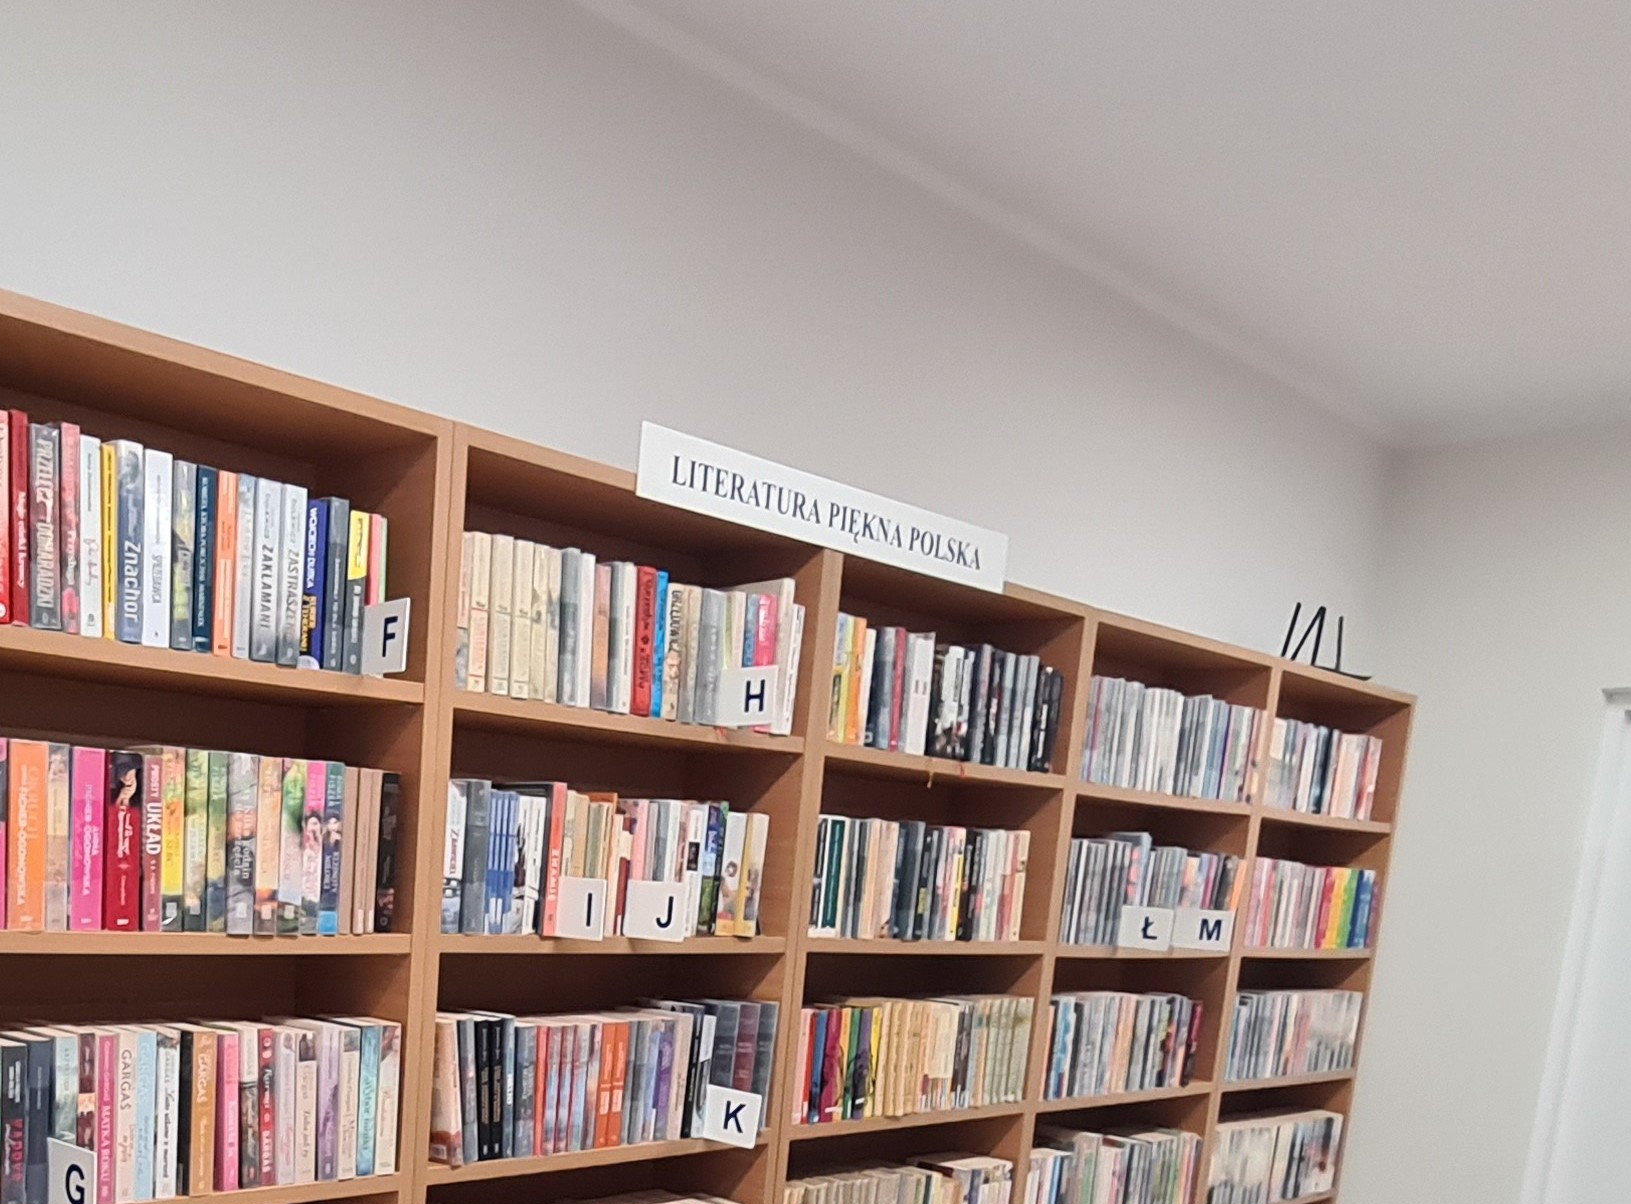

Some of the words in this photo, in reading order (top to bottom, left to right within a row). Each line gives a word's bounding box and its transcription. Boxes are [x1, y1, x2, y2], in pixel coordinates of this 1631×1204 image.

[671, 455, 821, 525] LITERATURA
[828, 502, 903, 544] PIĘKNA
[908, 527, 982, 571] POLSKA
[308, 507, 319, 557] WOJCIECH
[123, 539, 142, 624] Znachor
[305, 557, 318, 589] DUTKA
[382, 616, 398, 657] F
[744, 679, 766, 713] H
[149, 765, 160, 798] PROSTY
[145, 802, 162, 855] UKŁAD
[586, 893, 593, 927] I
[656, 896, 674, 928] J
[1141, 916, 1158, 940] Ł
[1198, 918, 1223, 941] M
[119, 1050, 133, 1111] GARGAŚ
[100, 1105, 113, 1149] MATKA
[723, 1100, 746, 1134] K
[101, 1149, 113, 1182] ROKU
